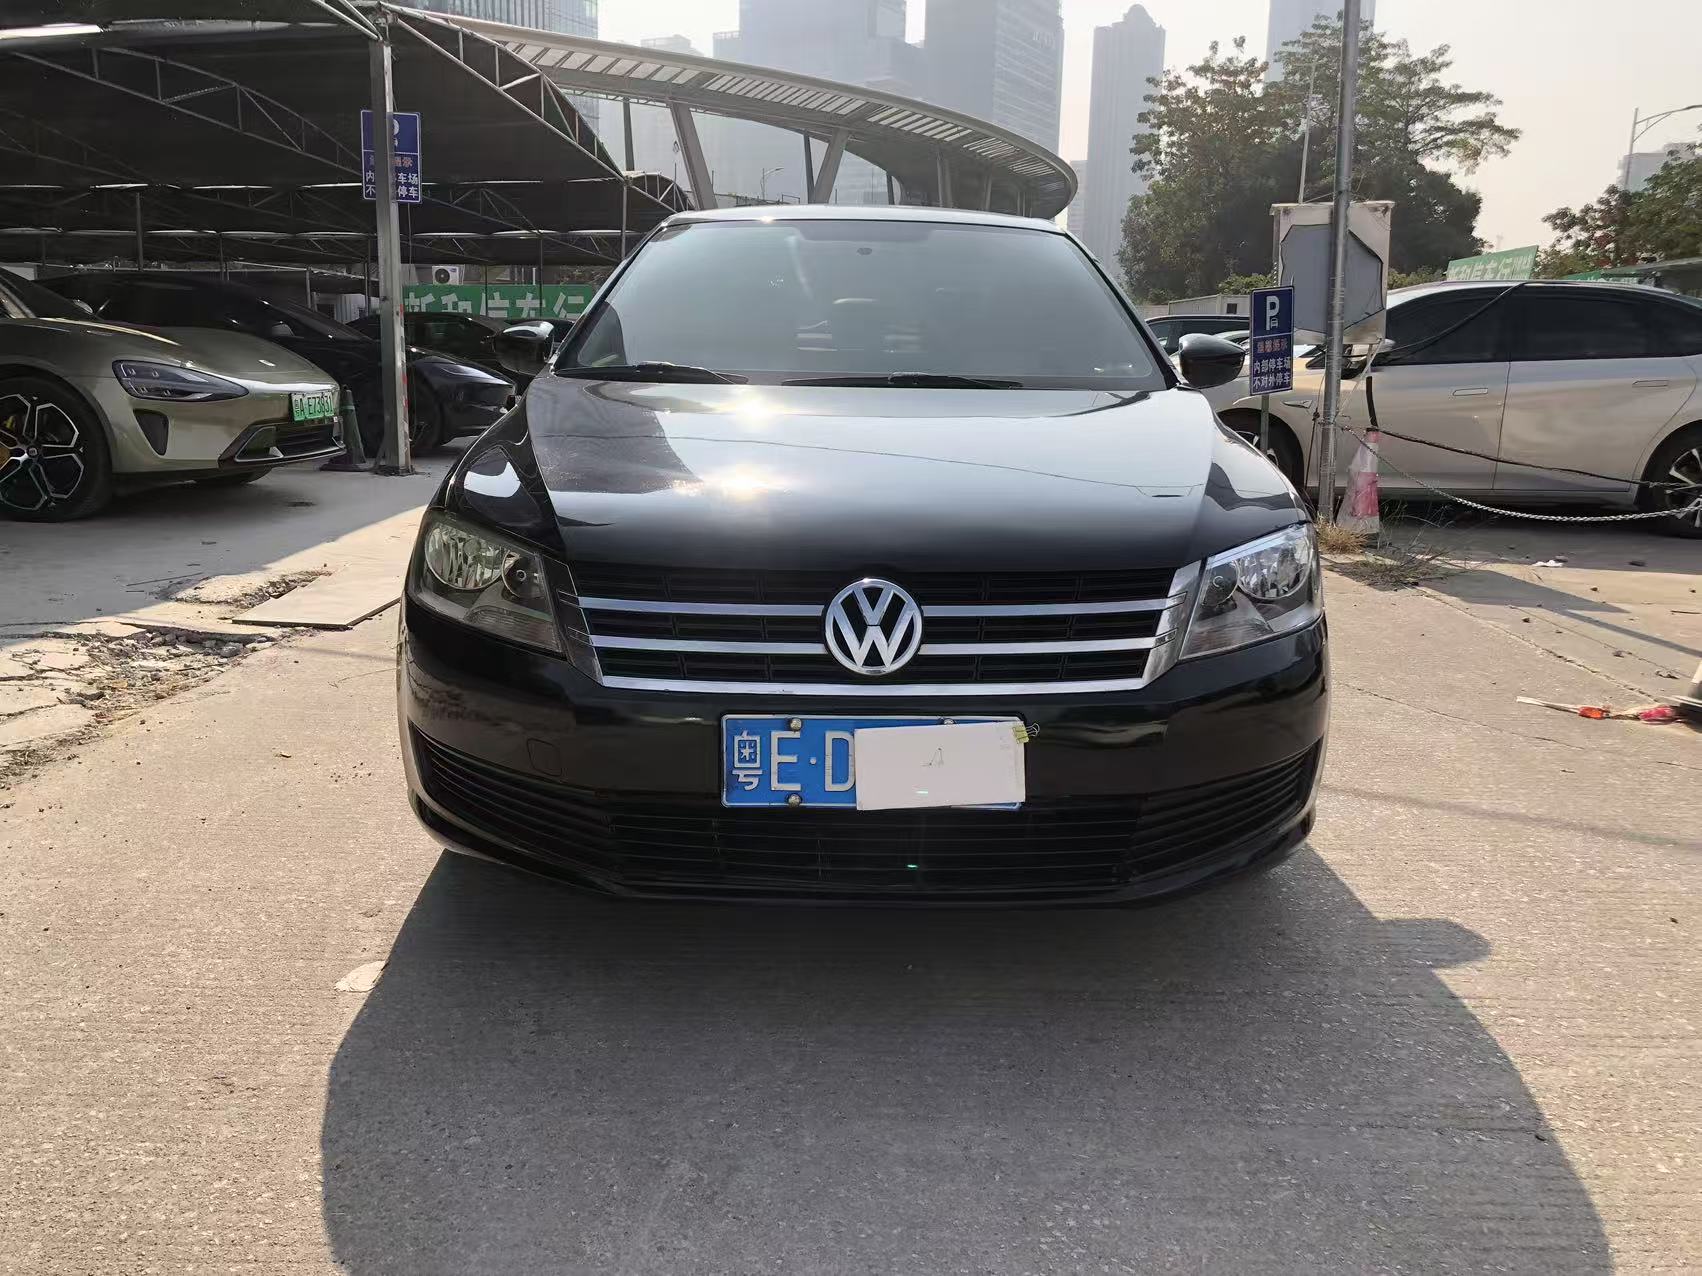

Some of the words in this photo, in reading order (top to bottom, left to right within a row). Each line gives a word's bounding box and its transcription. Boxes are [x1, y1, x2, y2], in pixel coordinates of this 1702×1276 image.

[366, 170, 418, 185] 内车场
[366, 184, 419, 198] 不停车
[1265, 295, 1280, 330] P
[1253, 357, 1291, 375] 内部停车场
[1253, 372, 1290, 390] 不对外停车
